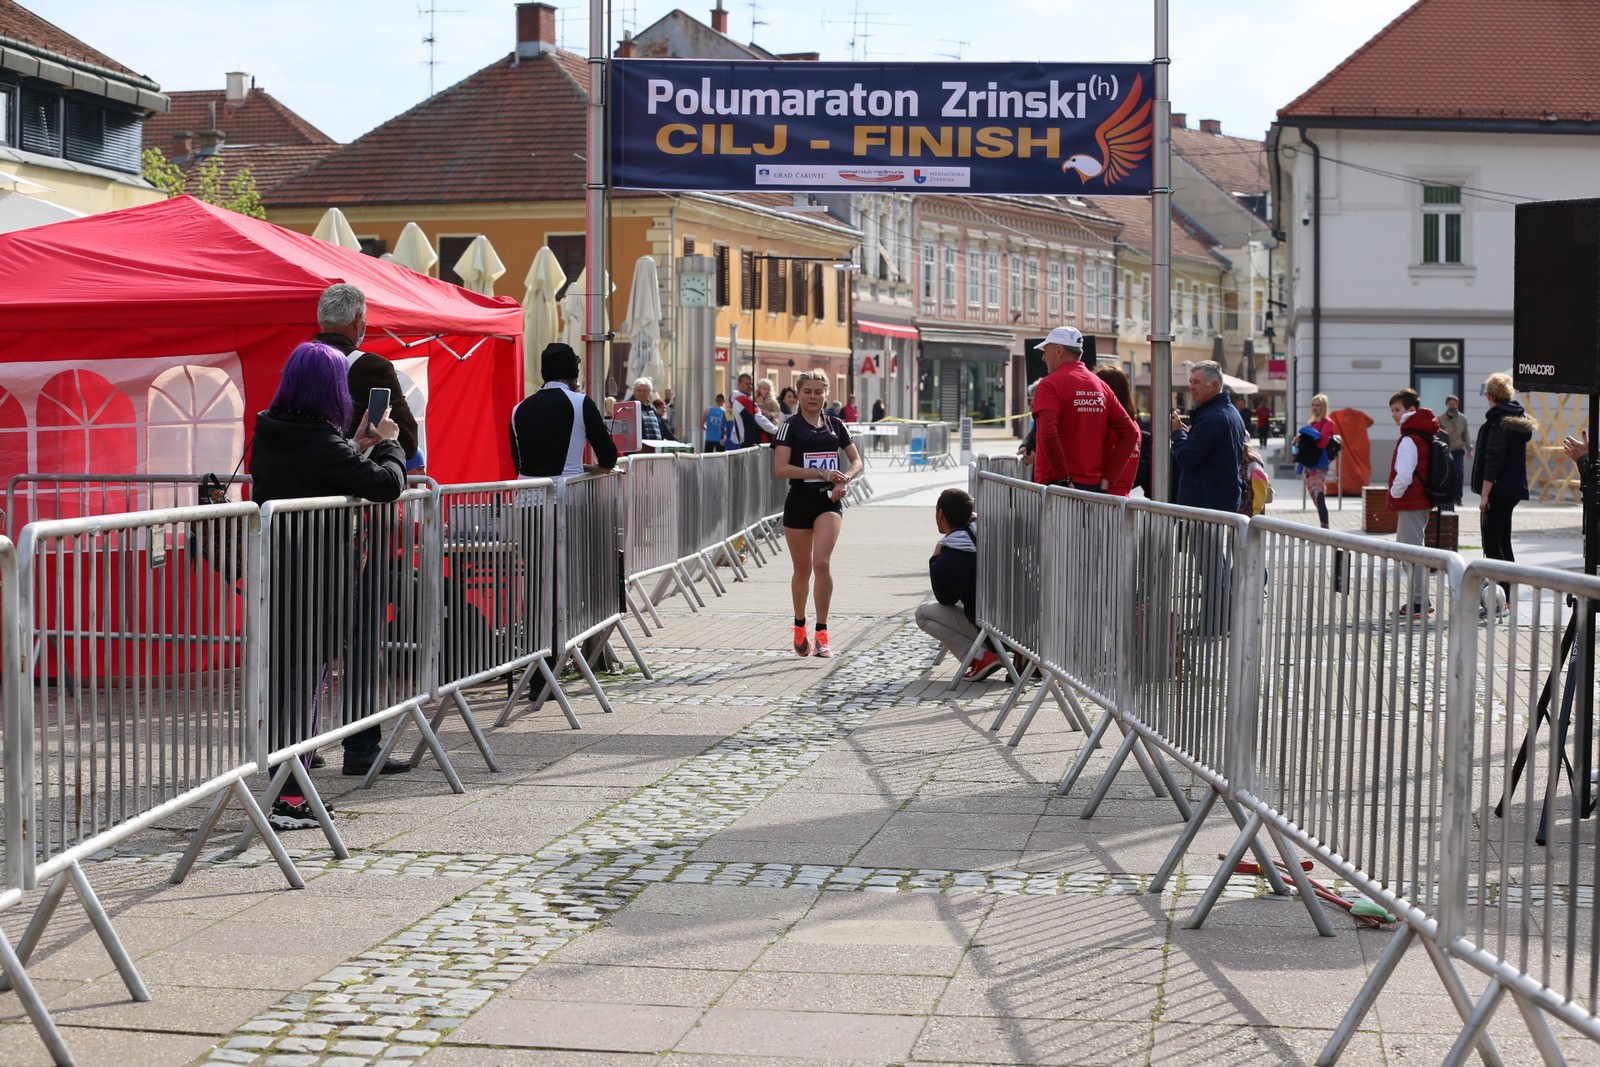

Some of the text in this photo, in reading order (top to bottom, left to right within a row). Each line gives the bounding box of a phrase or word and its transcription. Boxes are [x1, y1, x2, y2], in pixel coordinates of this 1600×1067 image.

[647, 77, 919, 117] Polumaraton
[655, 123, 788, 156] CILJ
[853, 125, 1061, 159] FINISH
[795, 171, 826, 179] ČAKOVEC
[860, 353, 880, 375] A1
[1518, 363, 1555, 376] DYNACORD
